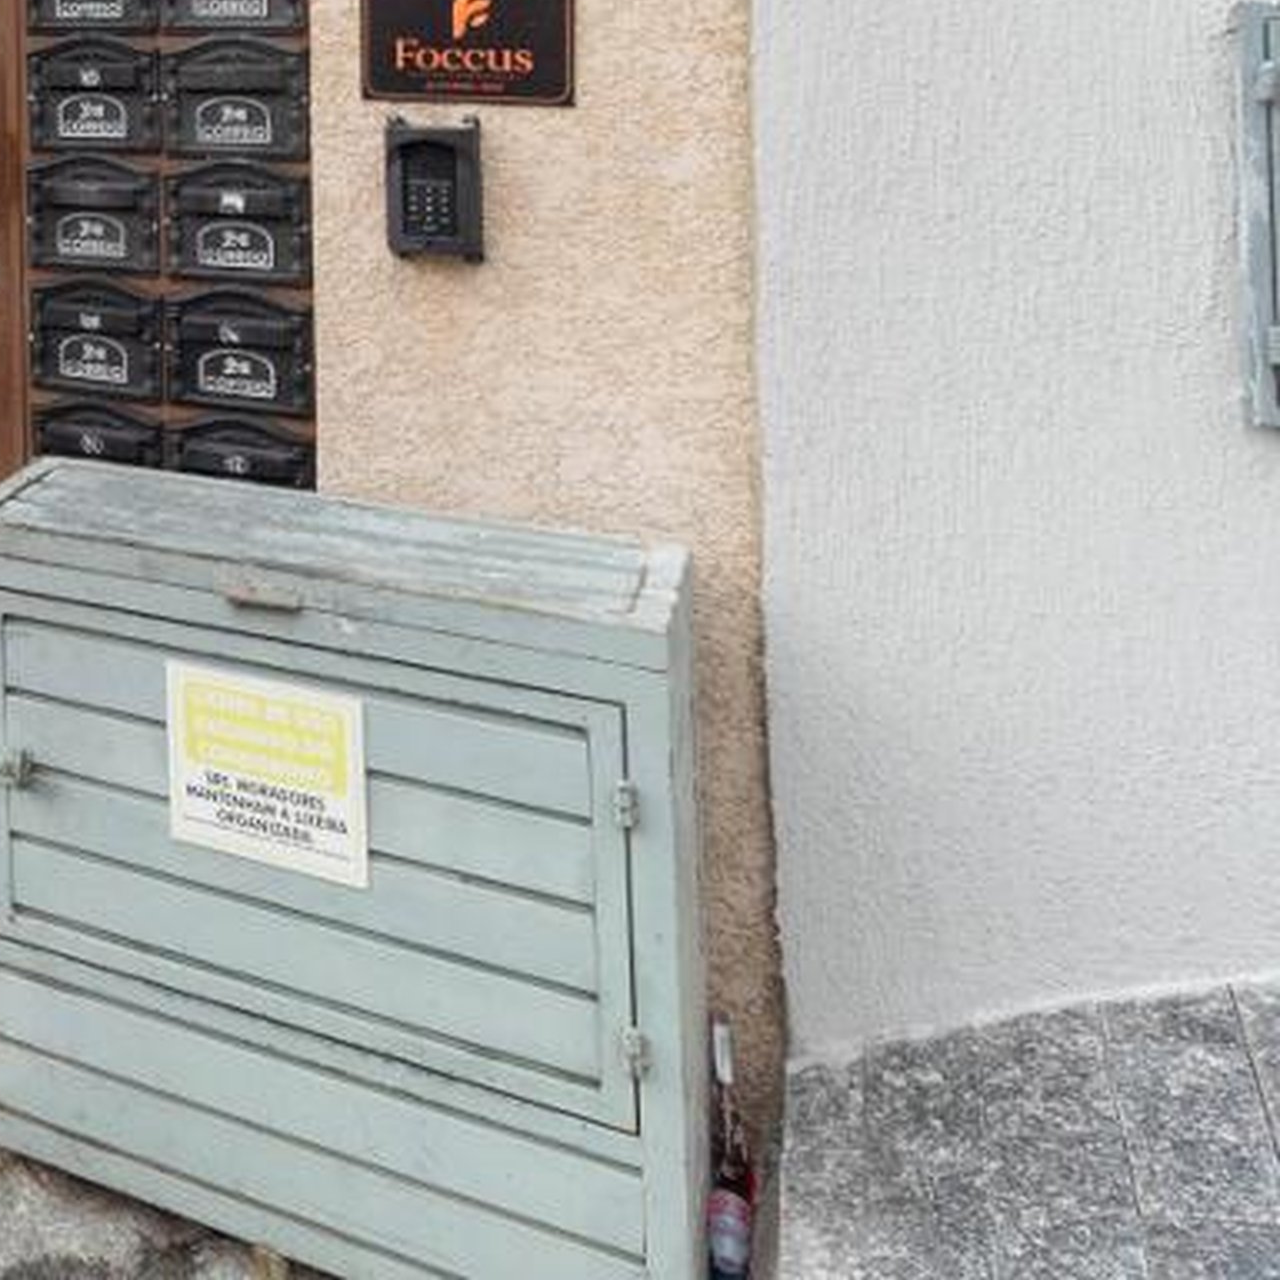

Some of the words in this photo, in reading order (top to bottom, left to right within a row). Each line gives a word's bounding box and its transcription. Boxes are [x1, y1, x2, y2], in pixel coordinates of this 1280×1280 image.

[394, 36, 536, 73] Foccus
[186, 785, 277, 817] MANTENHAM
[294, 811, 348, 835] LIXEIRA
[237, 778, 326, 812] MORADORES
